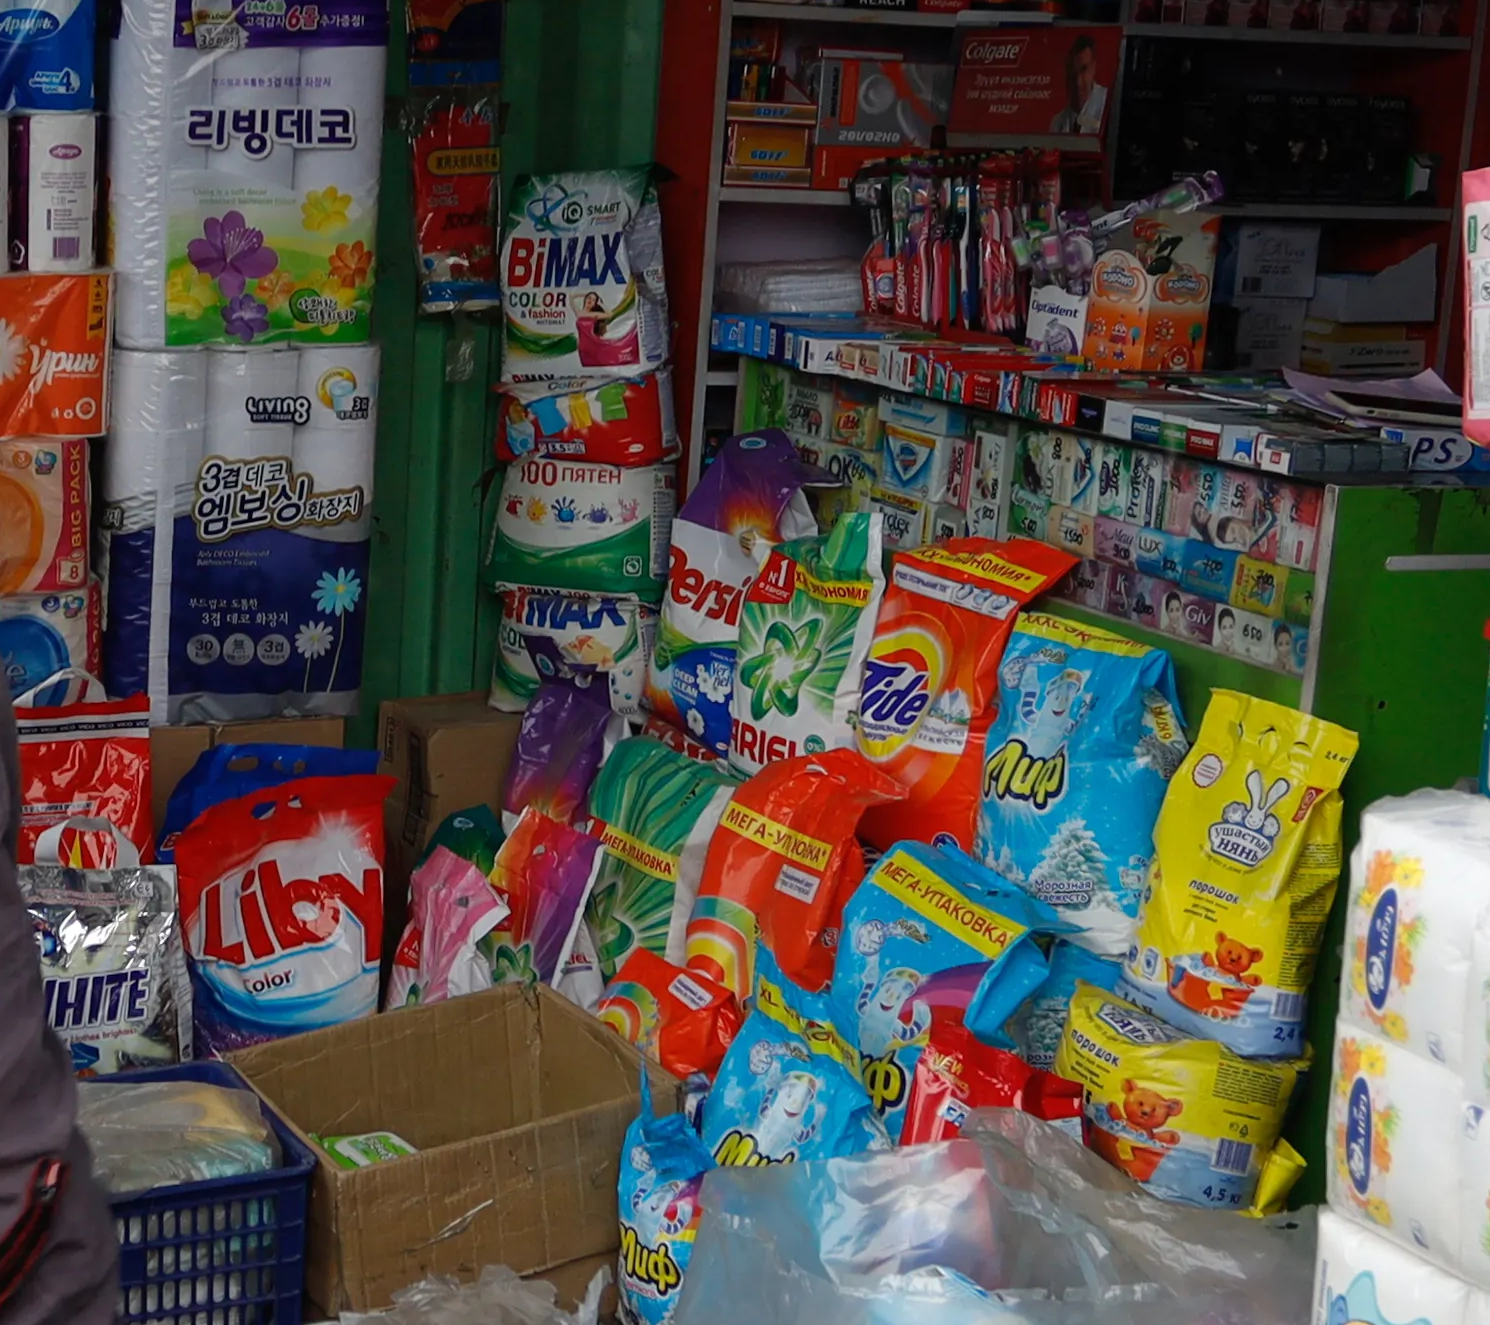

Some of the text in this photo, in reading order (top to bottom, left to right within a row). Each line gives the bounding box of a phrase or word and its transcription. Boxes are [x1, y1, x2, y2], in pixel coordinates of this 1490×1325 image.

[965, 42, 1020, 64] Colgate
[188, 108, 354, 156] 리빙데코
[587, 202, 621, 215] SMART
[507, 233, 627, 288] BiMAX
[508, 292, 567, 308] COLOR
[528, 308, 567, 319] fashion
[203, 463, 286, 495] 3겹 데코
[561, 468, 622, 486] ПЯТЕН
[69, 444, 82, 550] BIG PACK
[197, 480, 360, 537] 엠보싱 화장지
[670, 545, 751, 626] Persi
[202, 612, 289, 627] 3겹 데코 화장지
[1188, 878, 1240, 905] порошок
[202, 861, 379, 967] Liby
